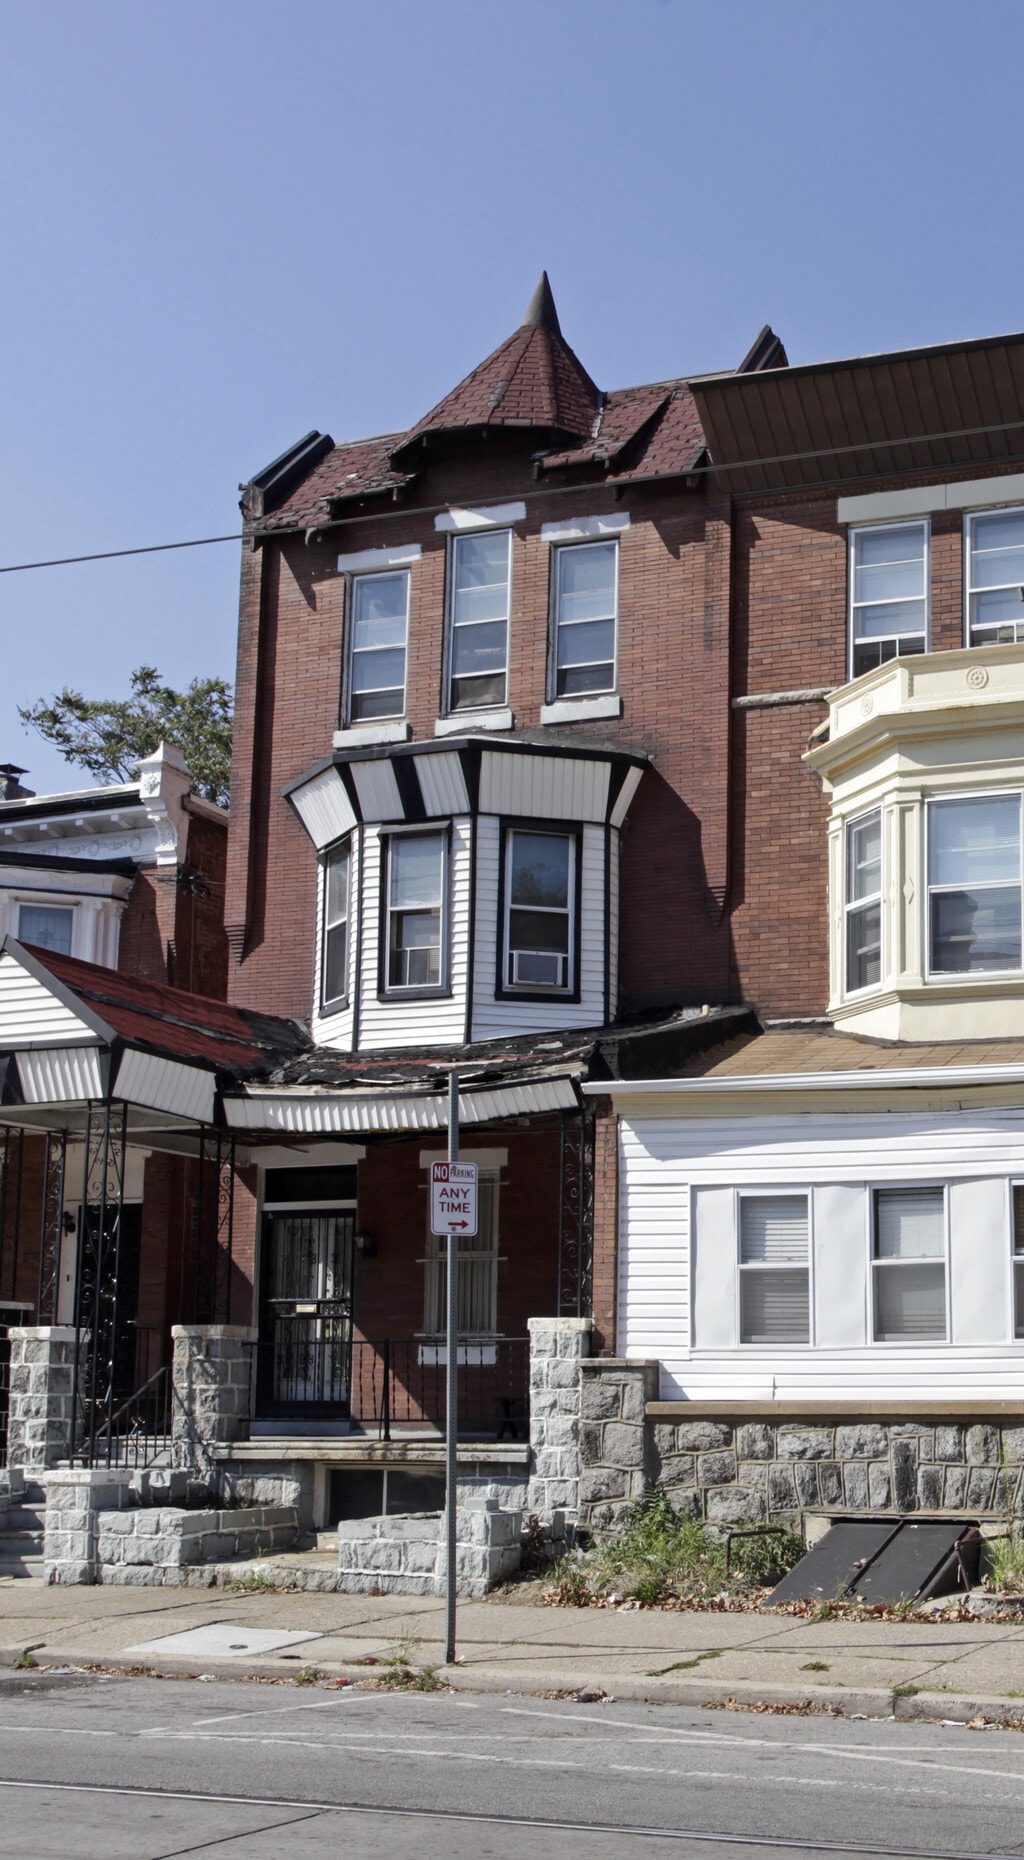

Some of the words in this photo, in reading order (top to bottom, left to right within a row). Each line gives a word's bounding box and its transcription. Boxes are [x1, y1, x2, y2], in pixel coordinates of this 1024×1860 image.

[434, 1165, 448, 1179] NO
[450, 1169, 474, 1179] PARKING
[439, 1187, 470, 1199] ANY
[438, 1202, 471, 1214] TIME
